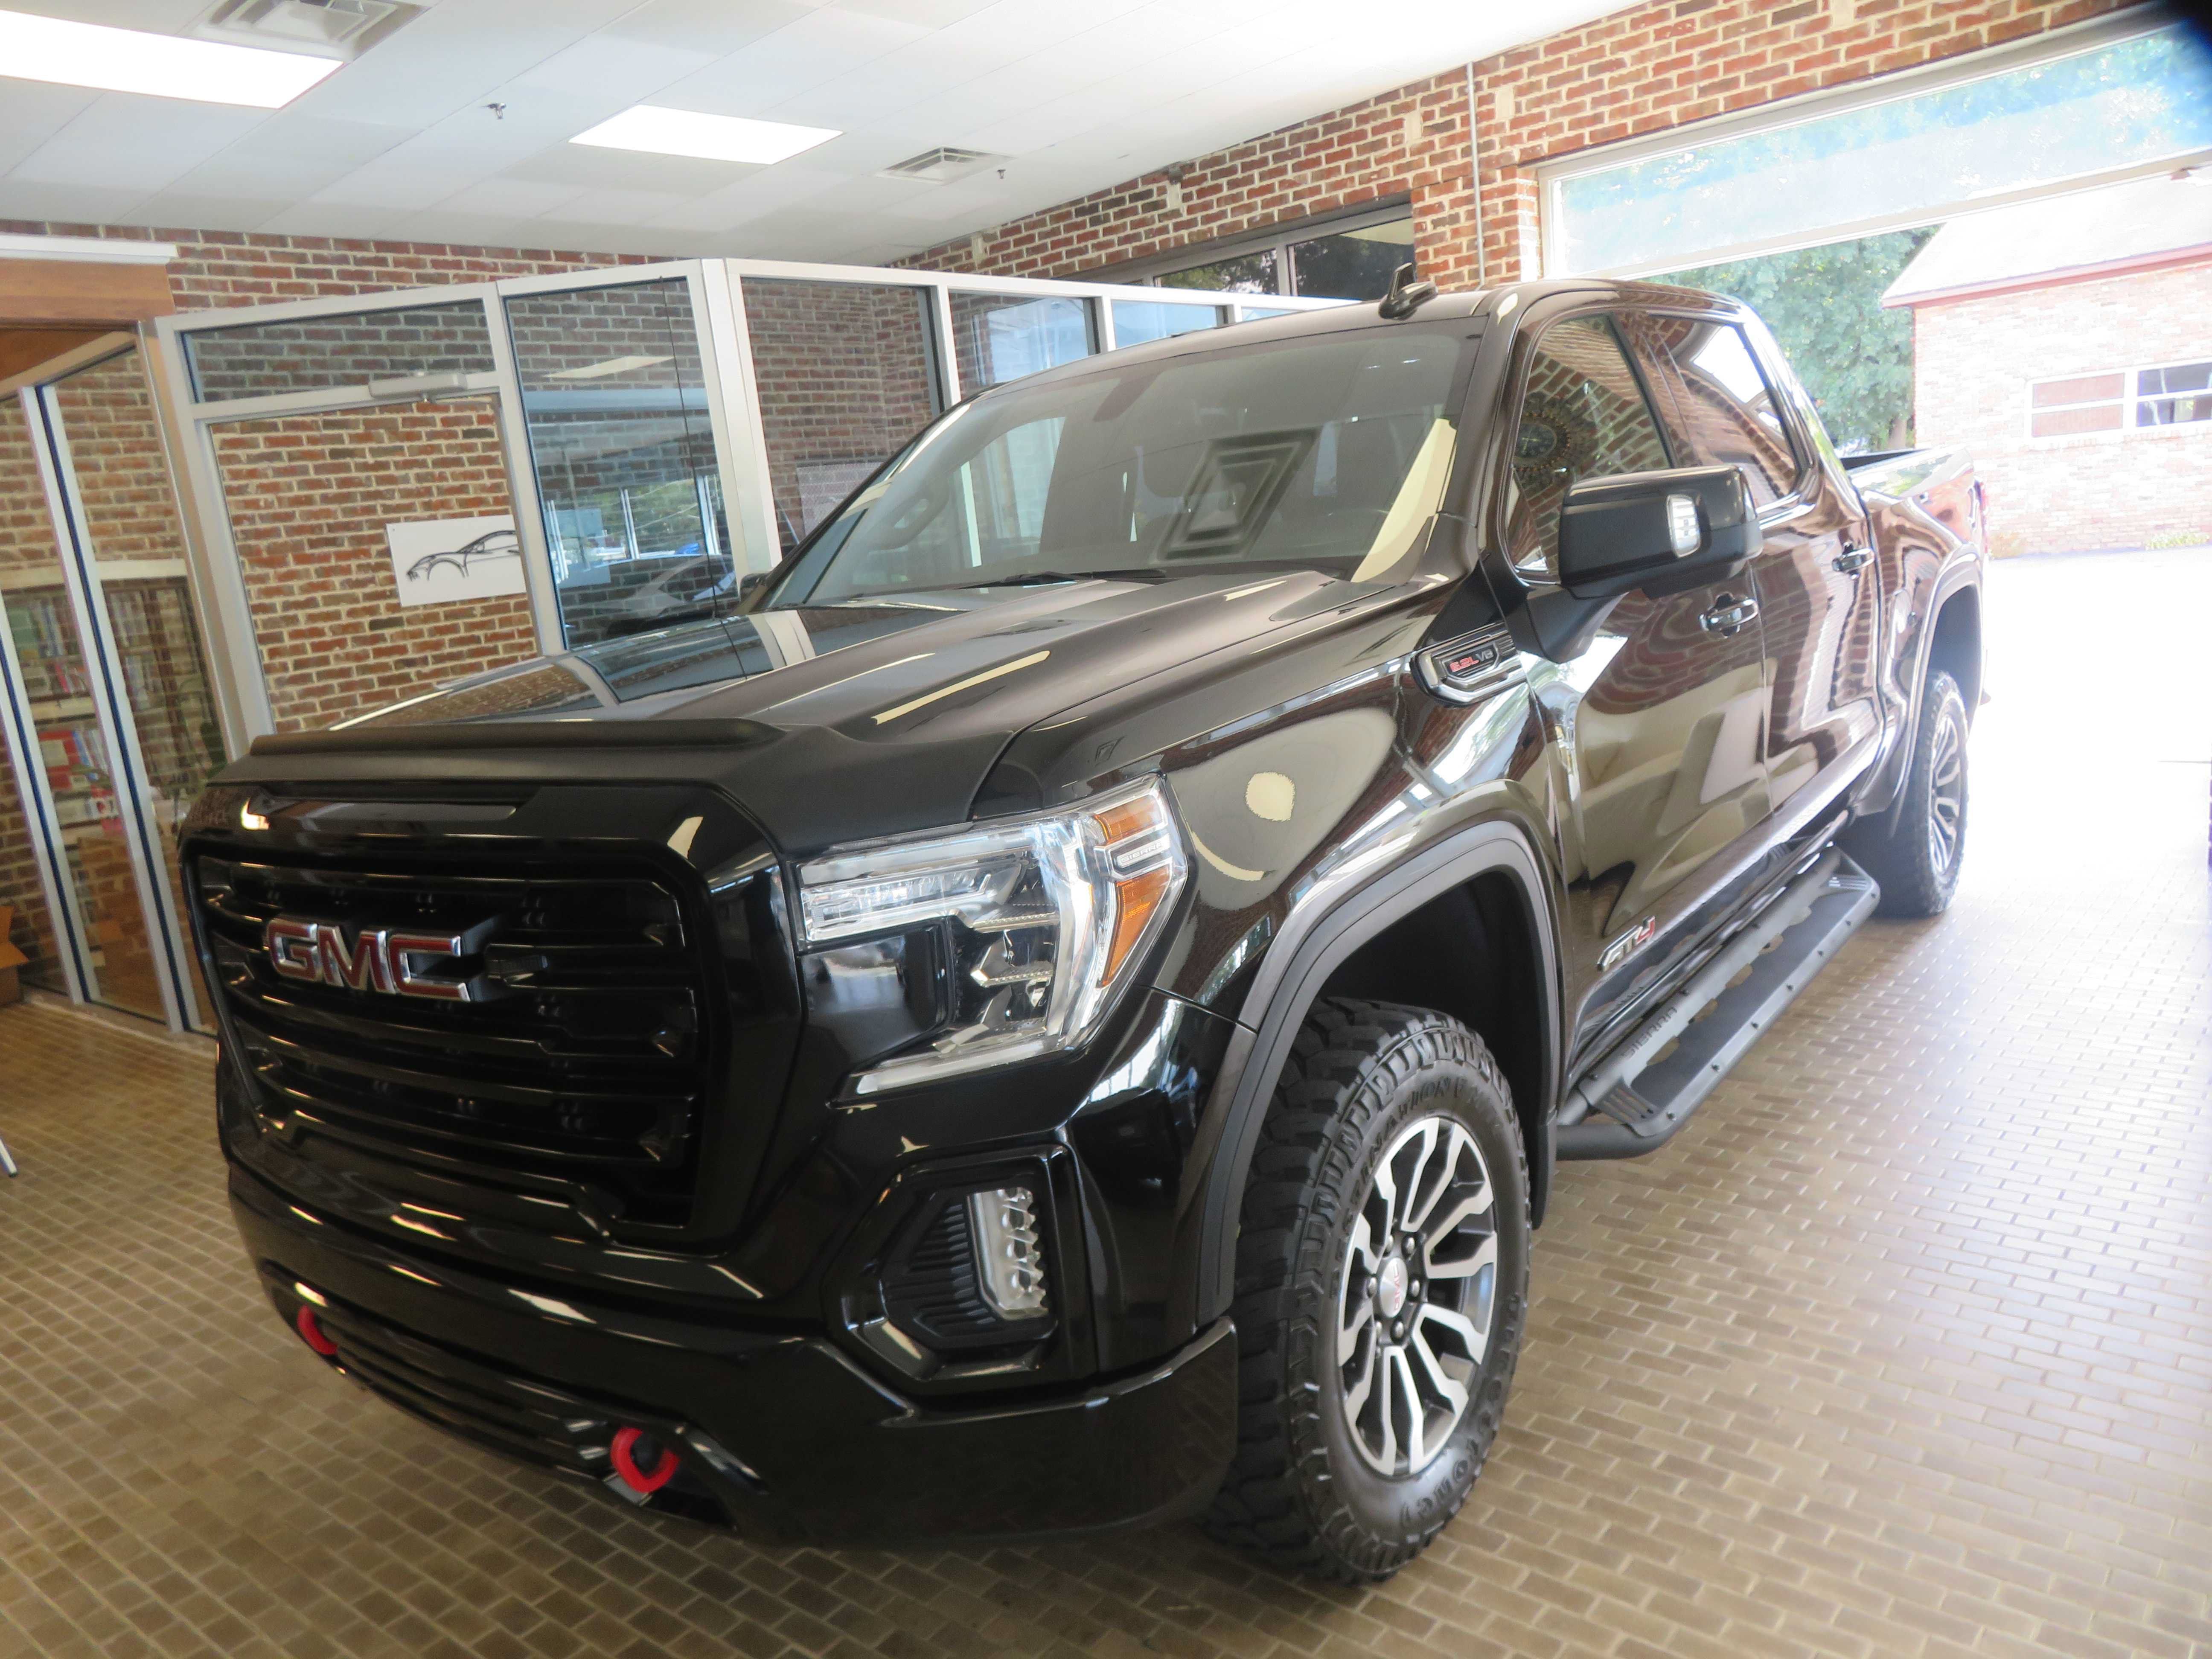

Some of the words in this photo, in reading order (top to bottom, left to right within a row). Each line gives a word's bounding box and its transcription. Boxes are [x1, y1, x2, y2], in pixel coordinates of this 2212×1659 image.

[1476, 649, 1494, 662] V8
[1121, 840, 1164, 864] SIERRA
[267, 918, 470, 1002] GMC
[1597, 915, 1656, 973] AT4
